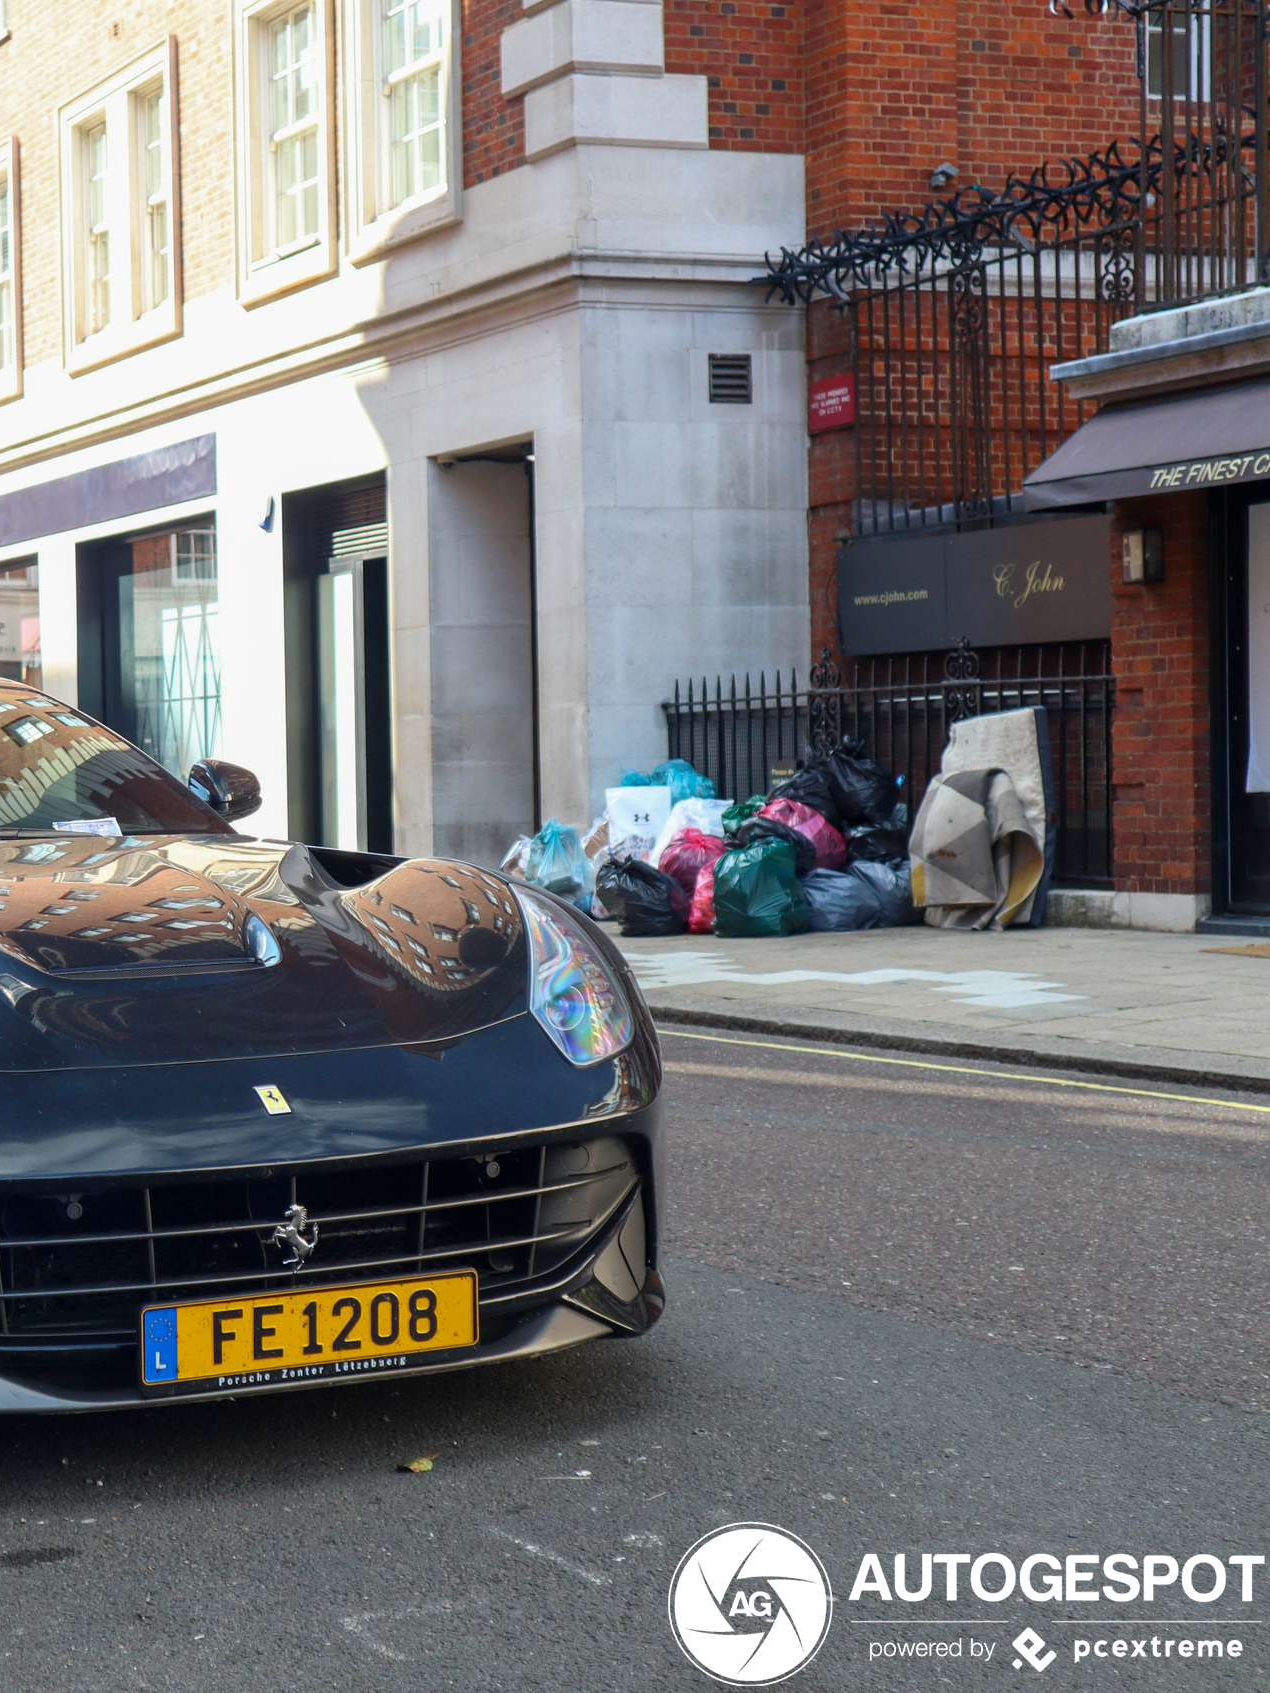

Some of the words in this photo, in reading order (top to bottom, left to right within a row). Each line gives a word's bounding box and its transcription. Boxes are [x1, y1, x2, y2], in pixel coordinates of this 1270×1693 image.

[1150, 465, 1186, 489] THE
[1185, 456, 1255, 485] FINEST
[854, 589, 929, 606] www.cjohn.com
[1014, 561, 1066, 609] John
[155, 1351, 167, 1370] L
[218, 1372, 271, 1387] Porsche
[281, 1366, 324, 1379] Zenter
[335, 1355, 407, 1373] Lëtzebuerg
